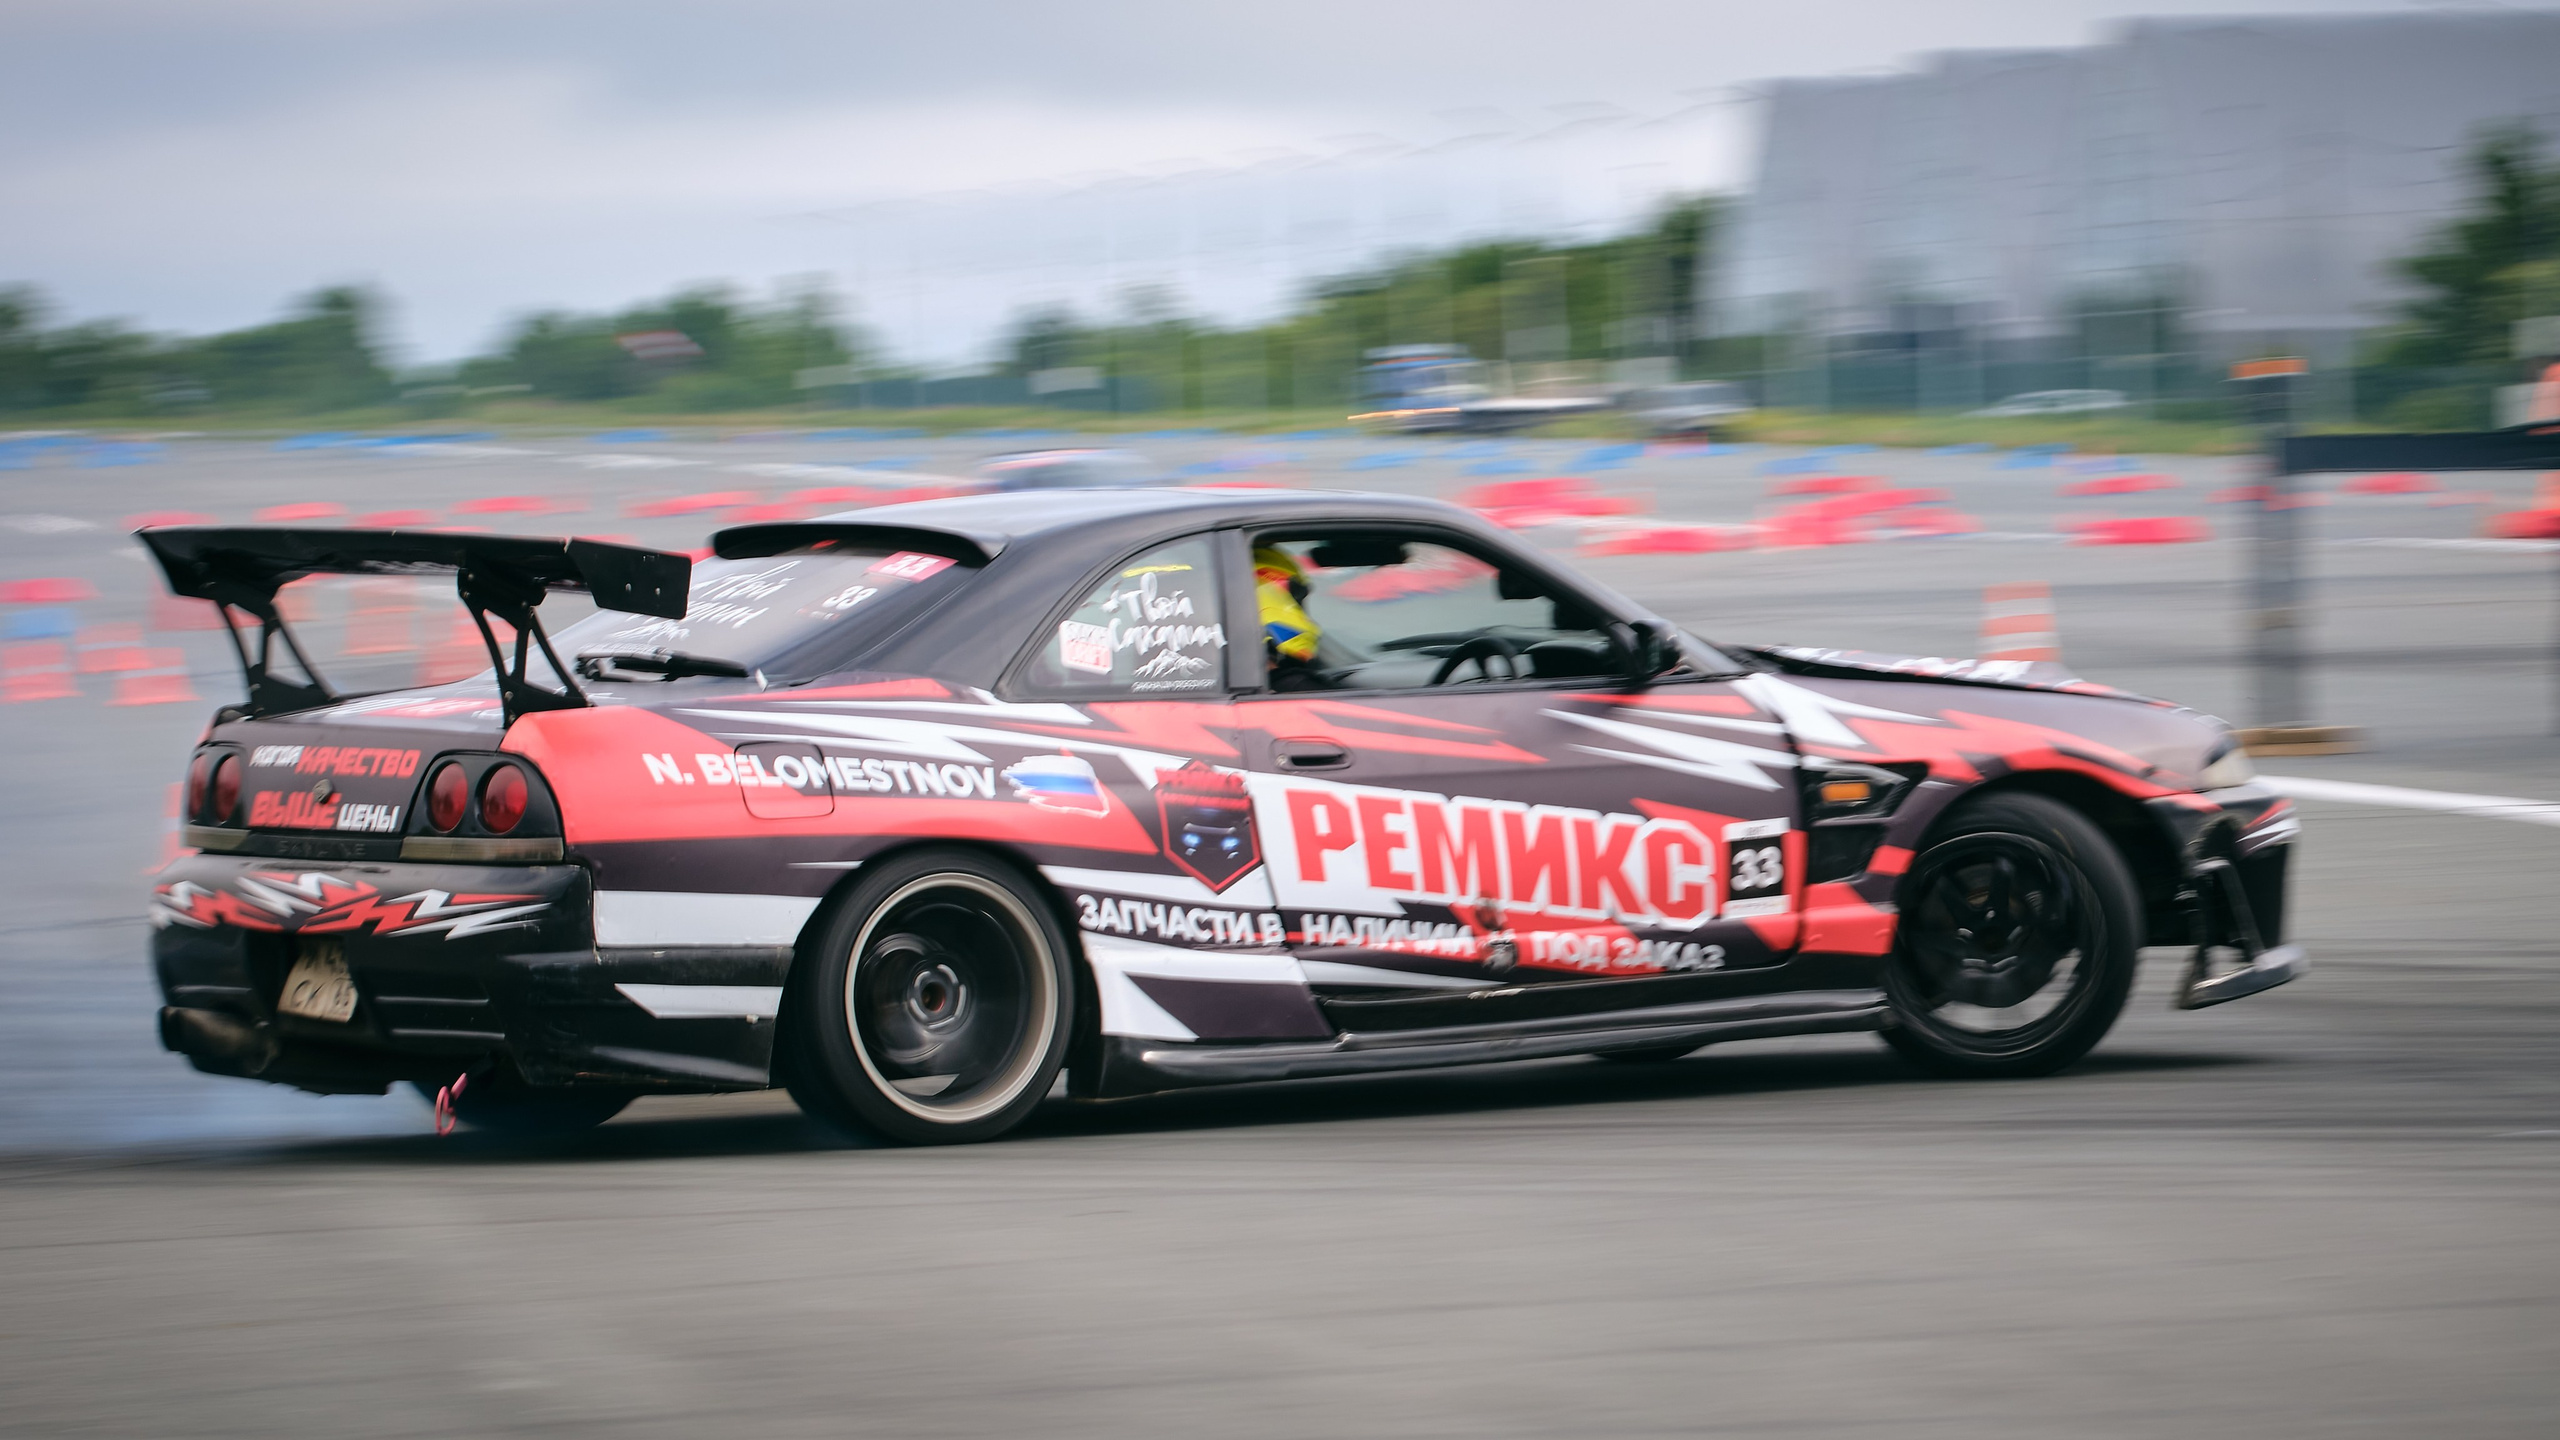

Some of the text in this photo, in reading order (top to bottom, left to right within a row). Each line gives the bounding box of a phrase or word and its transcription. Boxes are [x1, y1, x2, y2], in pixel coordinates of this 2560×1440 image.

[822, 585, 878, 611] 33
[294, 746, 421, 779] КАЧЕСТВО
[642, 753, 997, 799] N. BELOMESTNOV
[248, 790, 400, 833] ВЫШЕ ЦЕНЫ
[1285, 788, 1716, 922] РЕМИКС
[1729, 845, 1785, 891] 33
[1076, 894, 1256, 945] ЗАПЧАСТИ
[1257, 912, 1286, 946] В
[1301, 913, 1478, 957] НАЛИЧИИ
[1530, 930, 1609, 971] ПОД
[1611, 937, 1727, 972] ЗАКАЗ
